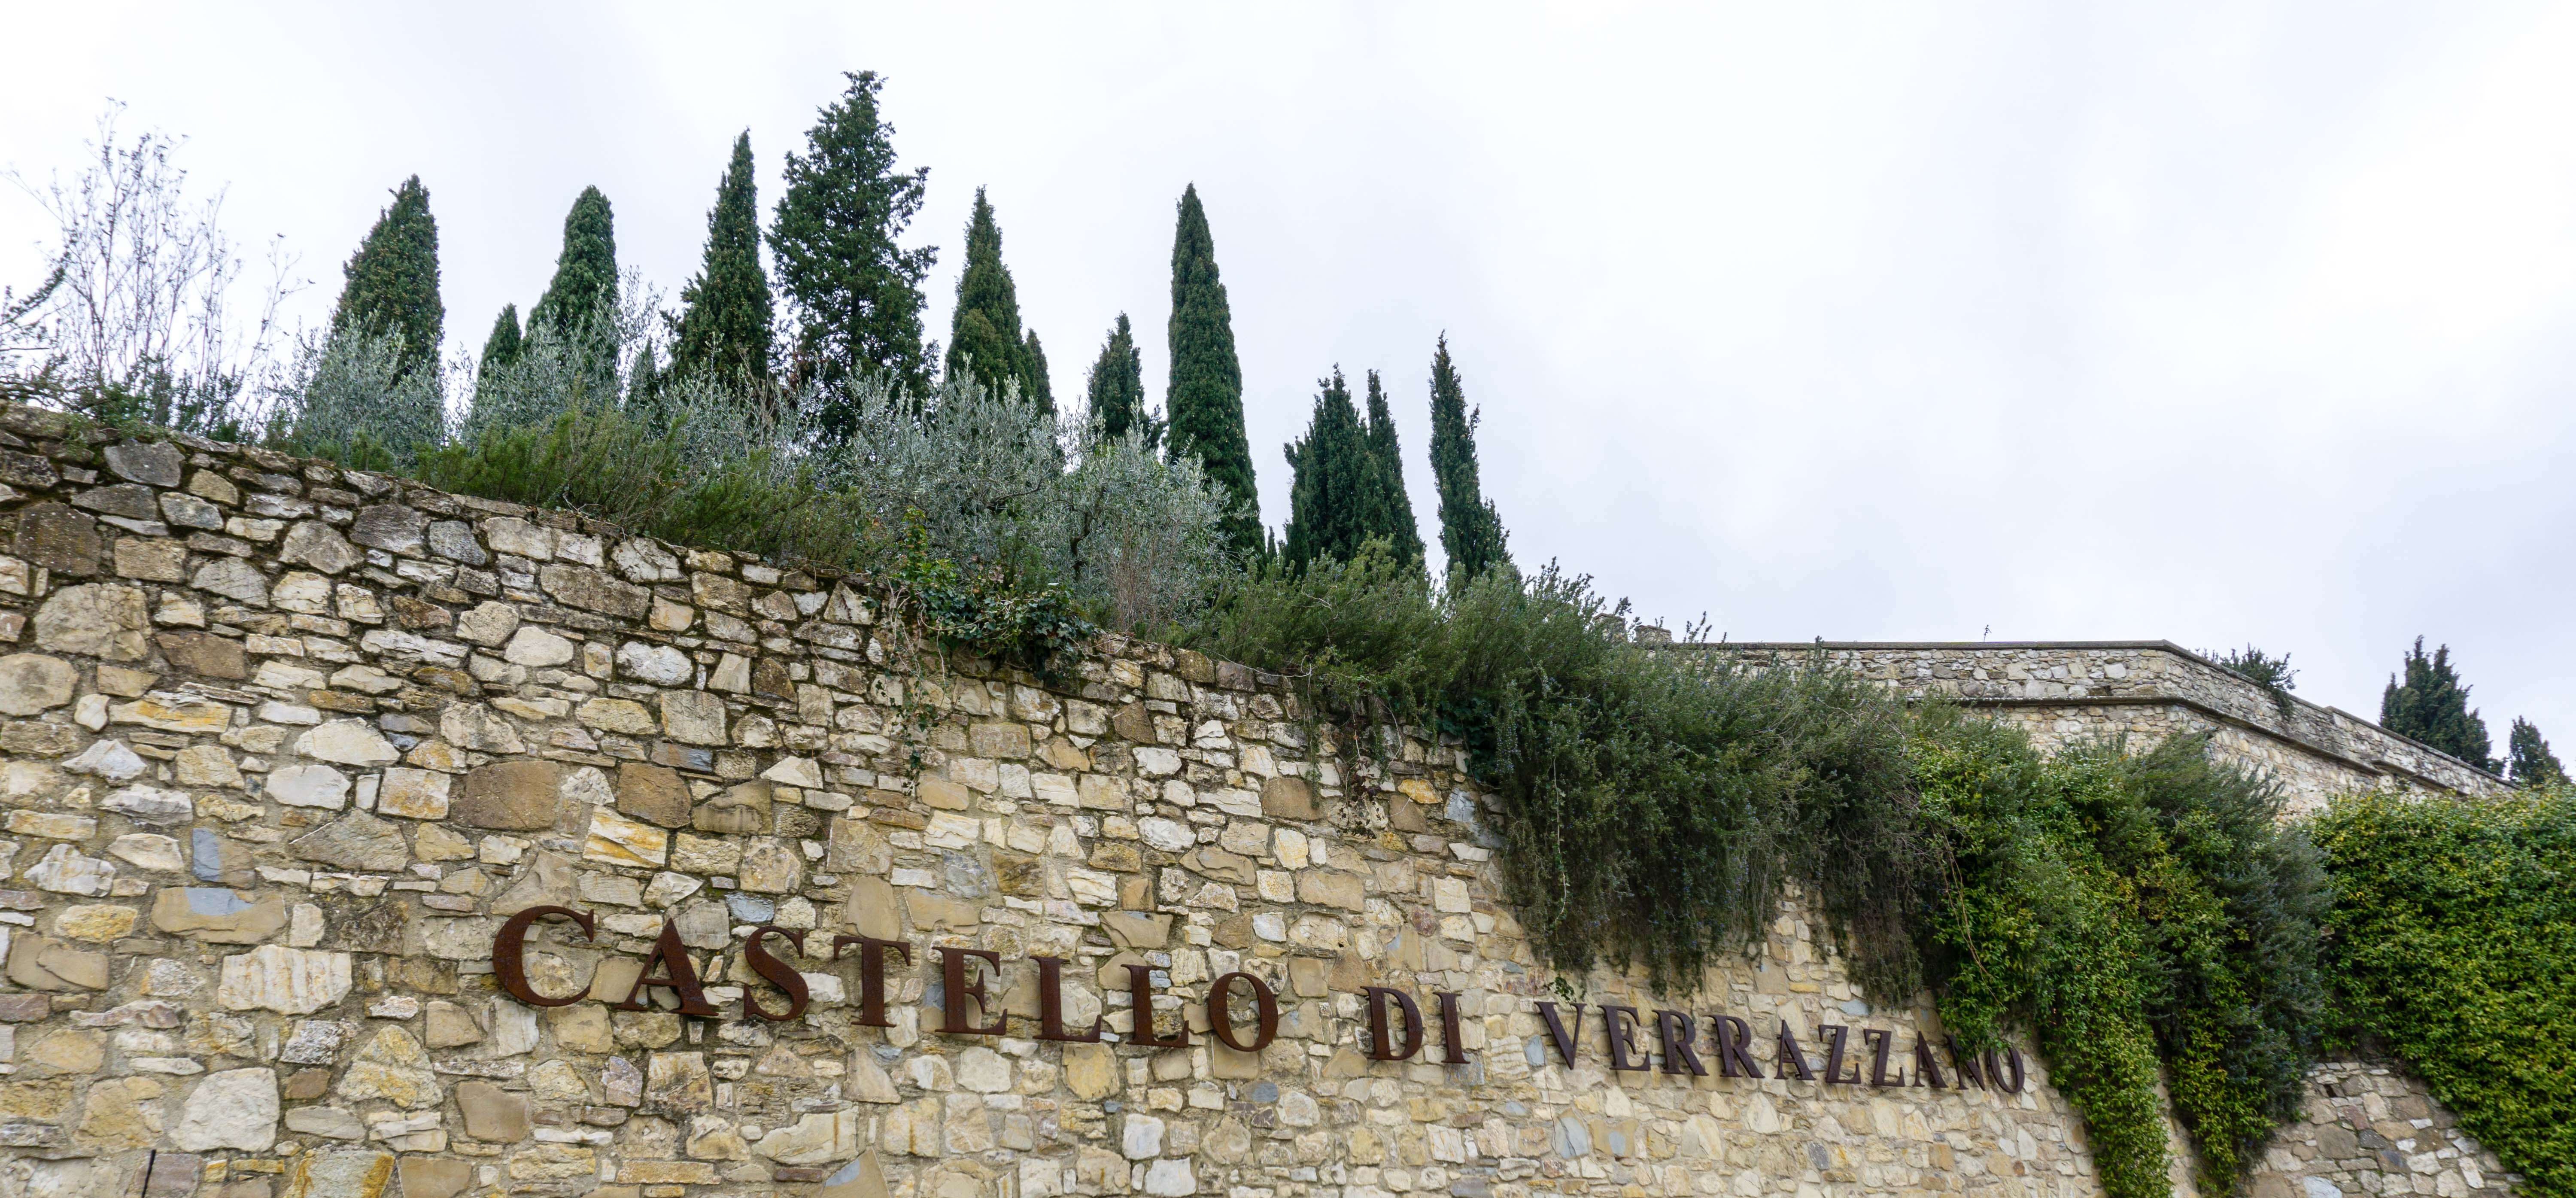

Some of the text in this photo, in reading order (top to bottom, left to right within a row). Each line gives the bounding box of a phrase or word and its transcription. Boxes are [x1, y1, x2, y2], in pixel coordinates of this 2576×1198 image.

[492, 905, 2025, 1093] CASTELLO DI VERRAZZANO
